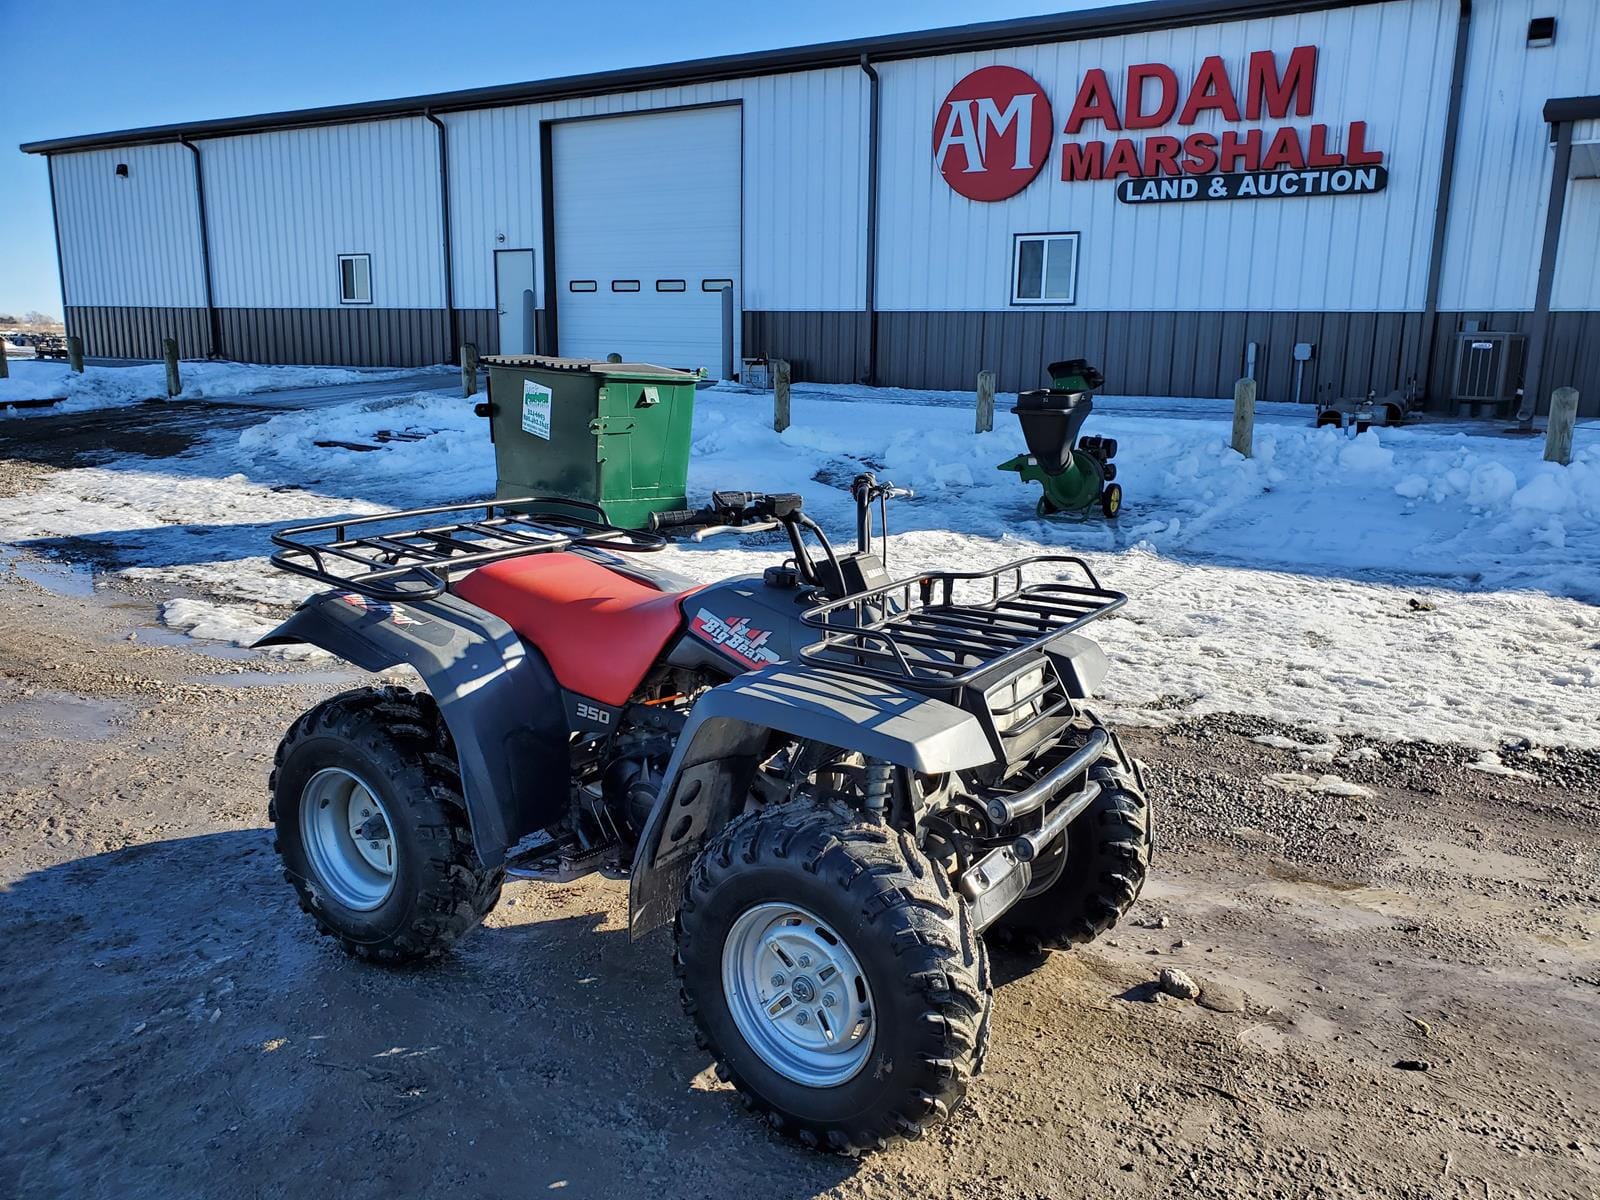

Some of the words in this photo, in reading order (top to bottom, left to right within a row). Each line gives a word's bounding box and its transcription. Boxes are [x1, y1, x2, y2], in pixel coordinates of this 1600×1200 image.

[1063, 45, 1318, 134] ADAM
[935, 93, 1037, 175] AM
[1061, 121, 1384, 182] MARSHALL
[1125, 177, 1199, 202] LAND
[1207, 176, 1229, 198] &
[1237, 168, 1377, 196] AUCTION
[700, 618, 730, 644] Big
[725, 633, 767, 663] Bear
[576, 702, 610, 725] 350
